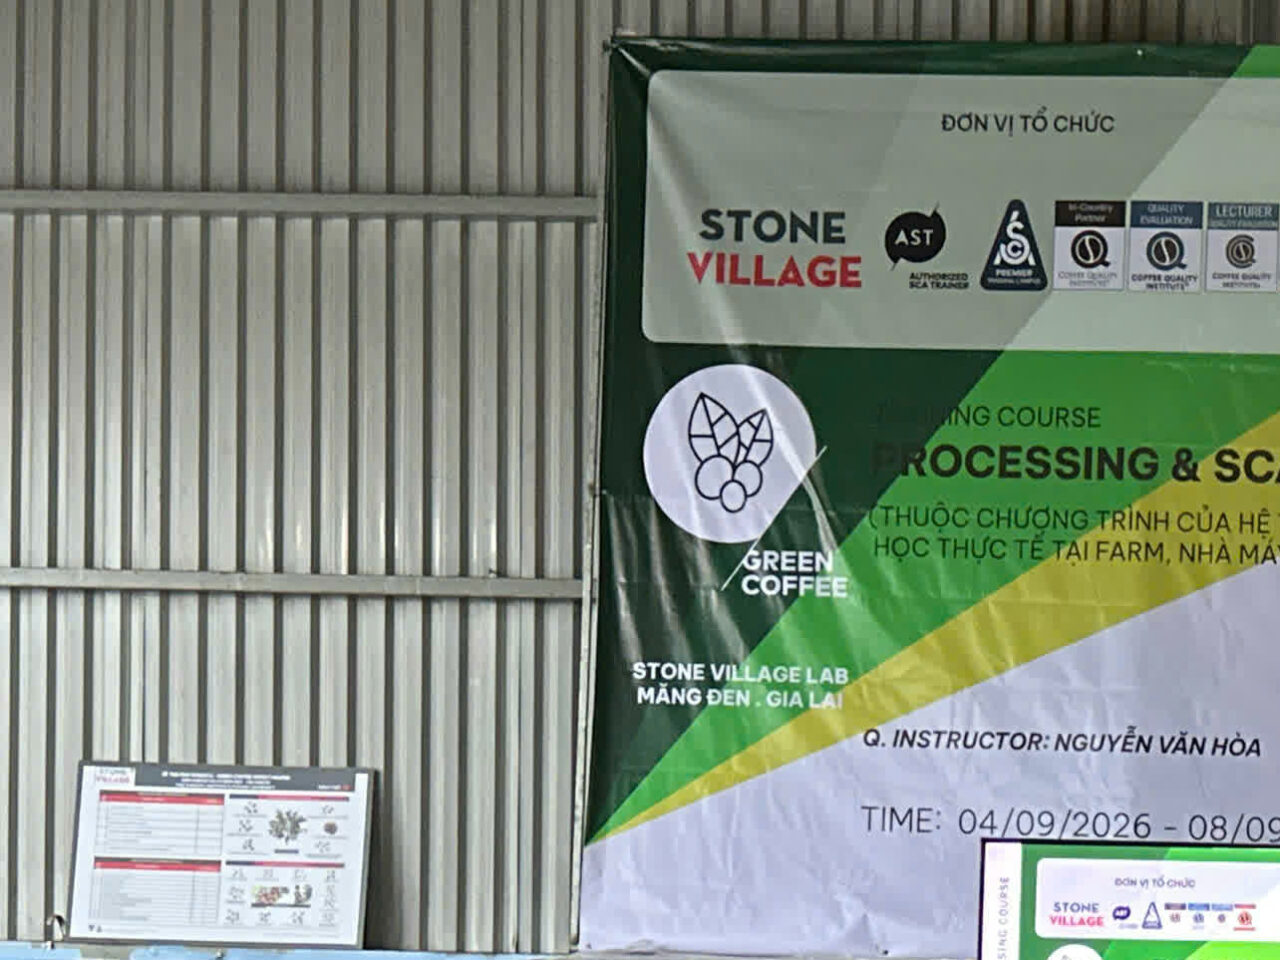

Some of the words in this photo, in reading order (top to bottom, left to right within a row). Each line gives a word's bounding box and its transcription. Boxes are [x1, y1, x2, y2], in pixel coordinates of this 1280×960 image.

[941, 112, 988, 132] ĐƠN
[994, 114, 1014, 137] VỊ
[1020, 105, 1048, 133] TỔ
[1053, 110, 1115, 133] CHỨC
[1216, 205, 1272, 218] LECTURER
[700, 209, 846, 245] STONE
[894, 229, 934, 246] AST
[688, 252, 862, 288] VILLAGE
[909, 272, 968, 281] AUTHORIZED
[999, 406, 1101, 428] COURSE
[1172, 448, 1201, 482] &
[869, 502, 969, 533] (THUỘC
[977, 507, 1088, 531] CHƯƠNG
[1096, 504, 1169, 531] TRÌNH
[1177, 504, 1231, 533] CỦA
[1239, 508, 1270, 539] HỆ
[874, 537, 930, 562] HỌC
[938, 536, 1006, 565] THỰC
[1013, 530, 1044, 560] TẾ
[1053, 540, 1088, 566] TẠI
[1096, 541, 1171, 566] FARM,
[1179, 537, 1231, 563] NHÀ
[742, 550, 834, 572] GREEN
[741, 575, 848, 598] COFFEE
[632, 662, 705, 681] STONE
[711, 664, 802, 683] VILLAGE
[806, 667, 848, 684] LAB
[637, 683, 702, 705] MĂNG
[706, 688, 750, 707] ĐEN
[766, 690, 803, 708] GIA
[809, 692, 843, 709] LAI
[863, 729, 886, 748] Q.
[892, 729, 1051, 751] INSTRUCTOR:
[1054, 725, 1152, 753] NGUYỄN
[1159, 730, 1206, 756] VĂN
[1211, 732, 1262, 757] HÒA
[861, 805, 941, 833] TIME:
[959, 807, 1152, 840] 04/09/2026
[1053, 902, 1099, 913] STONE
[1050, 915, 1103, 927] VILLAGE
